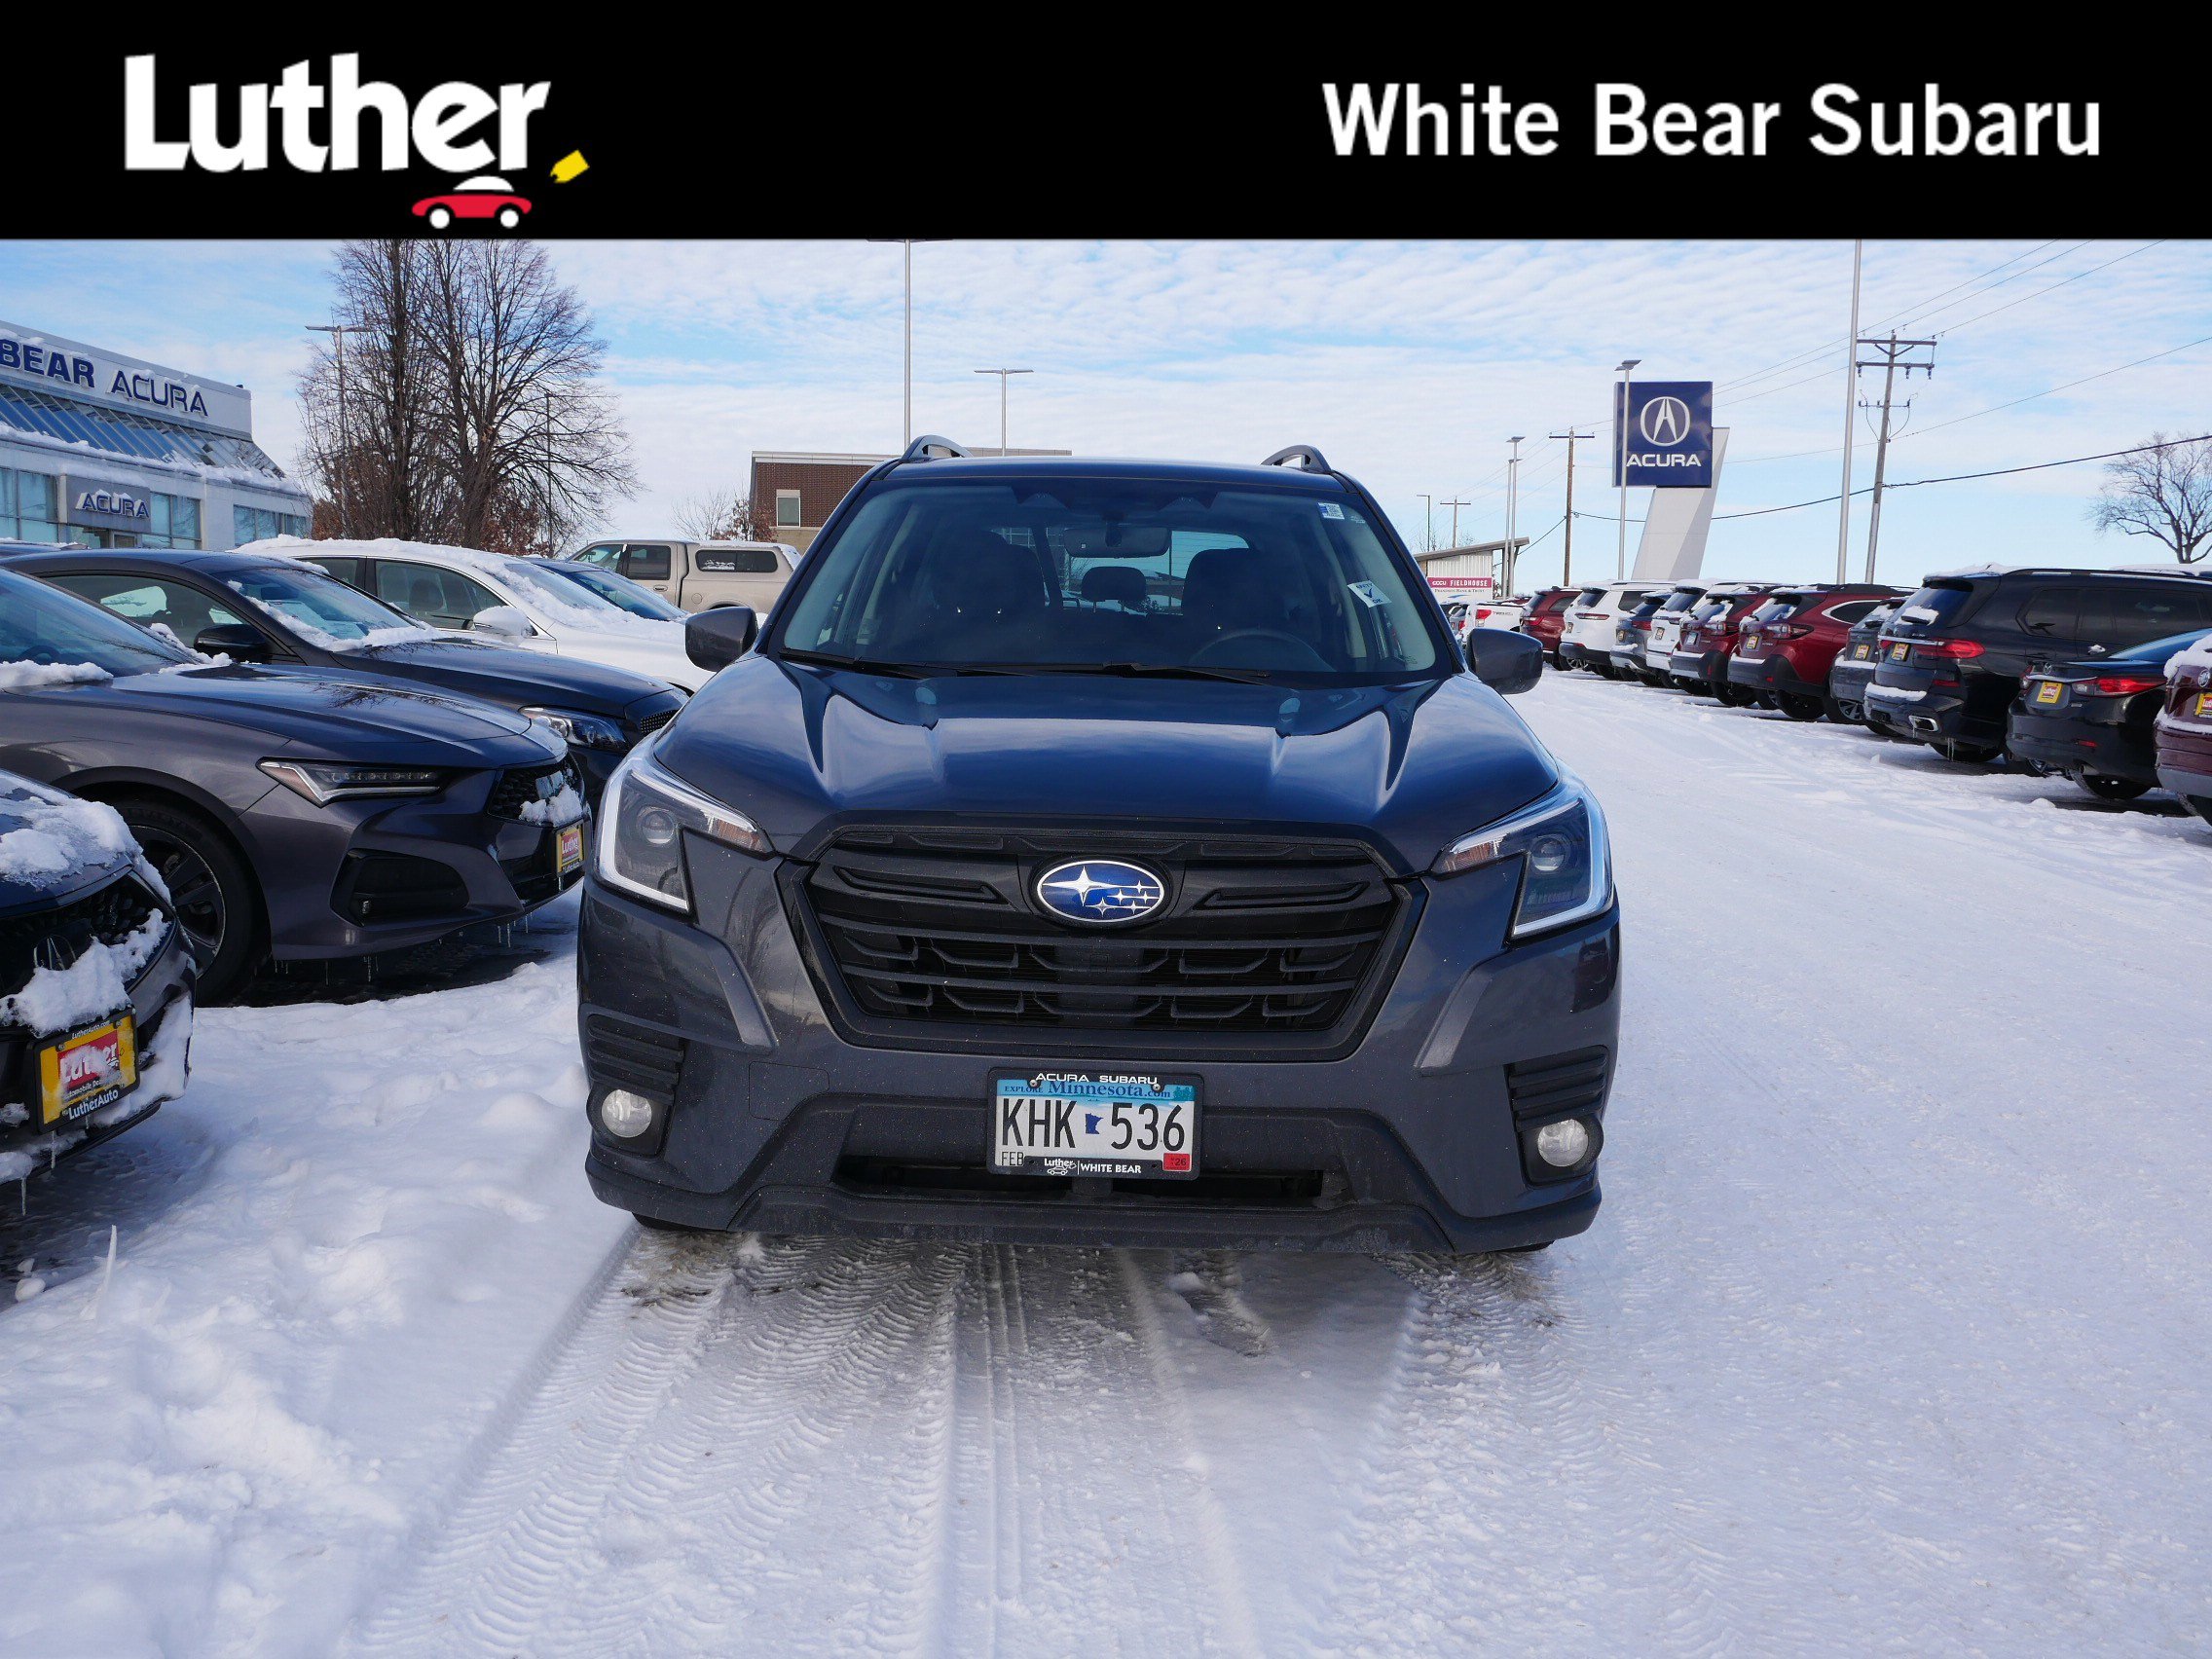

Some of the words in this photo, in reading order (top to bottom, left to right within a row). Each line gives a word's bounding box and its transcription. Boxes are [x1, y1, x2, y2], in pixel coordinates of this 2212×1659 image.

[0, 339, 95, 388] BEAR
[109, 369, 208, 417] ACURA
[1626, 454, 1702, 467] ACURA
[77, 491, 150, 519] ACURA
[1035, 1073, 1089, 1083] ACURA
[1099, 1075, 1158, 1085] SUBARU
[68, 1088, 119, 1120] LutherAuto
[1002, 1097, 1077, 1149] KHK
[1110, 1102, 1186, 1152] 536
[1001, 1151, 1024, 1166] FEB
[1044, 1158, 1074, 1168] Luther
[1081, 1163, 1113, 1173] WHITE
[1115, 1164, 1142, 1174] BEAR
